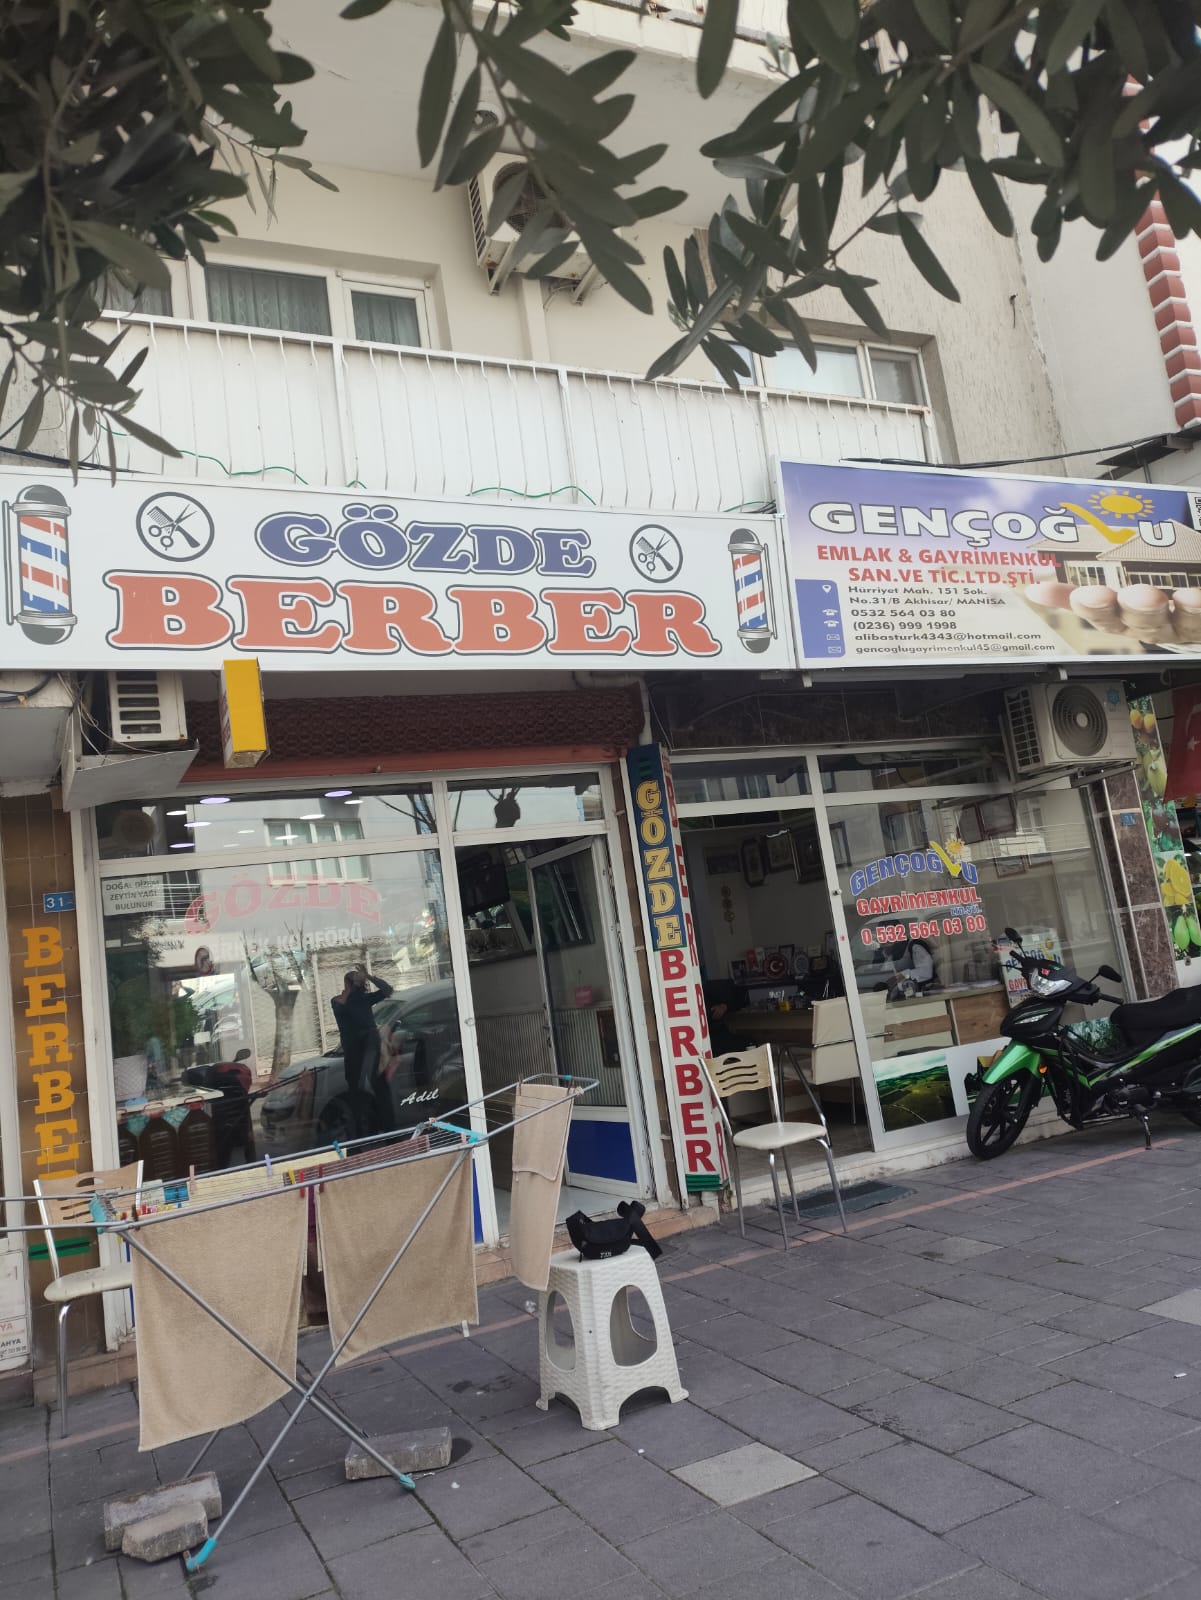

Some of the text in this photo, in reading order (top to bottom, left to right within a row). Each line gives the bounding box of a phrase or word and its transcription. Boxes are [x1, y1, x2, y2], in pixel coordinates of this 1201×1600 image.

[255, 503, 596, 577] GÖZDE
[817, 545, 1062, 568] EMLAK & GAYRİMENKUL
[848, 567, 924, 583] SAN.VE
[849, 597, 901, 605] No.31/B
[903, 587, 934, 595] Mah.
[937, 587, 958, 595] 151
[963, 587, 988, 595] Sok.
[102, 569, 722, 657] BERBER
[851, 609, 956, 617] 0532 564 03 80
[853, 621, 957, 631] (0236) 999 1998
[635, 780, 683, 949] GÖZDE
[856, 887, 981, 916] GAYRİMENKUL
[861, 914, 987, 945] 0 532 564 03 80
[22, 926, 80, 1180] BERBE
[660, 949, 716, 1173] BERBER
